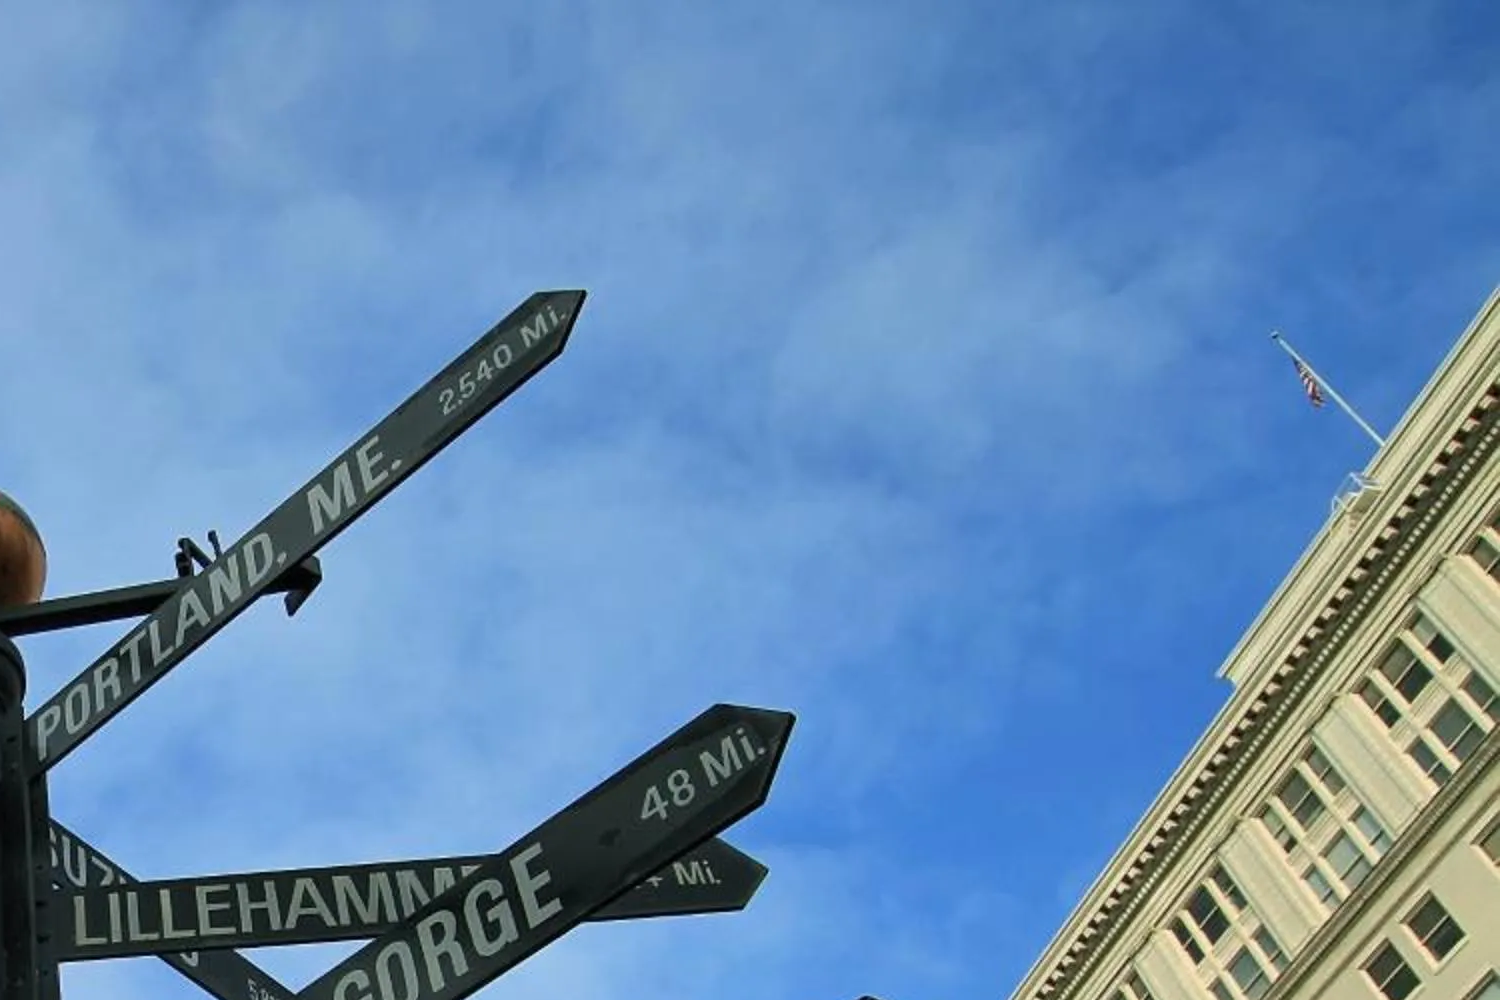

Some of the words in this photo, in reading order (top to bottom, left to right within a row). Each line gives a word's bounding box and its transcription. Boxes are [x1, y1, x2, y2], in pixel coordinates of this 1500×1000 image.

[306, 435, 403, 537] ME.
[519, 304, 566, 348] Mi.
[640, 769, 696, 820] 48
[699, 727, 765, 788] Mi.
[74, 864, 484, 946] LILLEHAMM
[672, 860, 721, 885] Mi.
